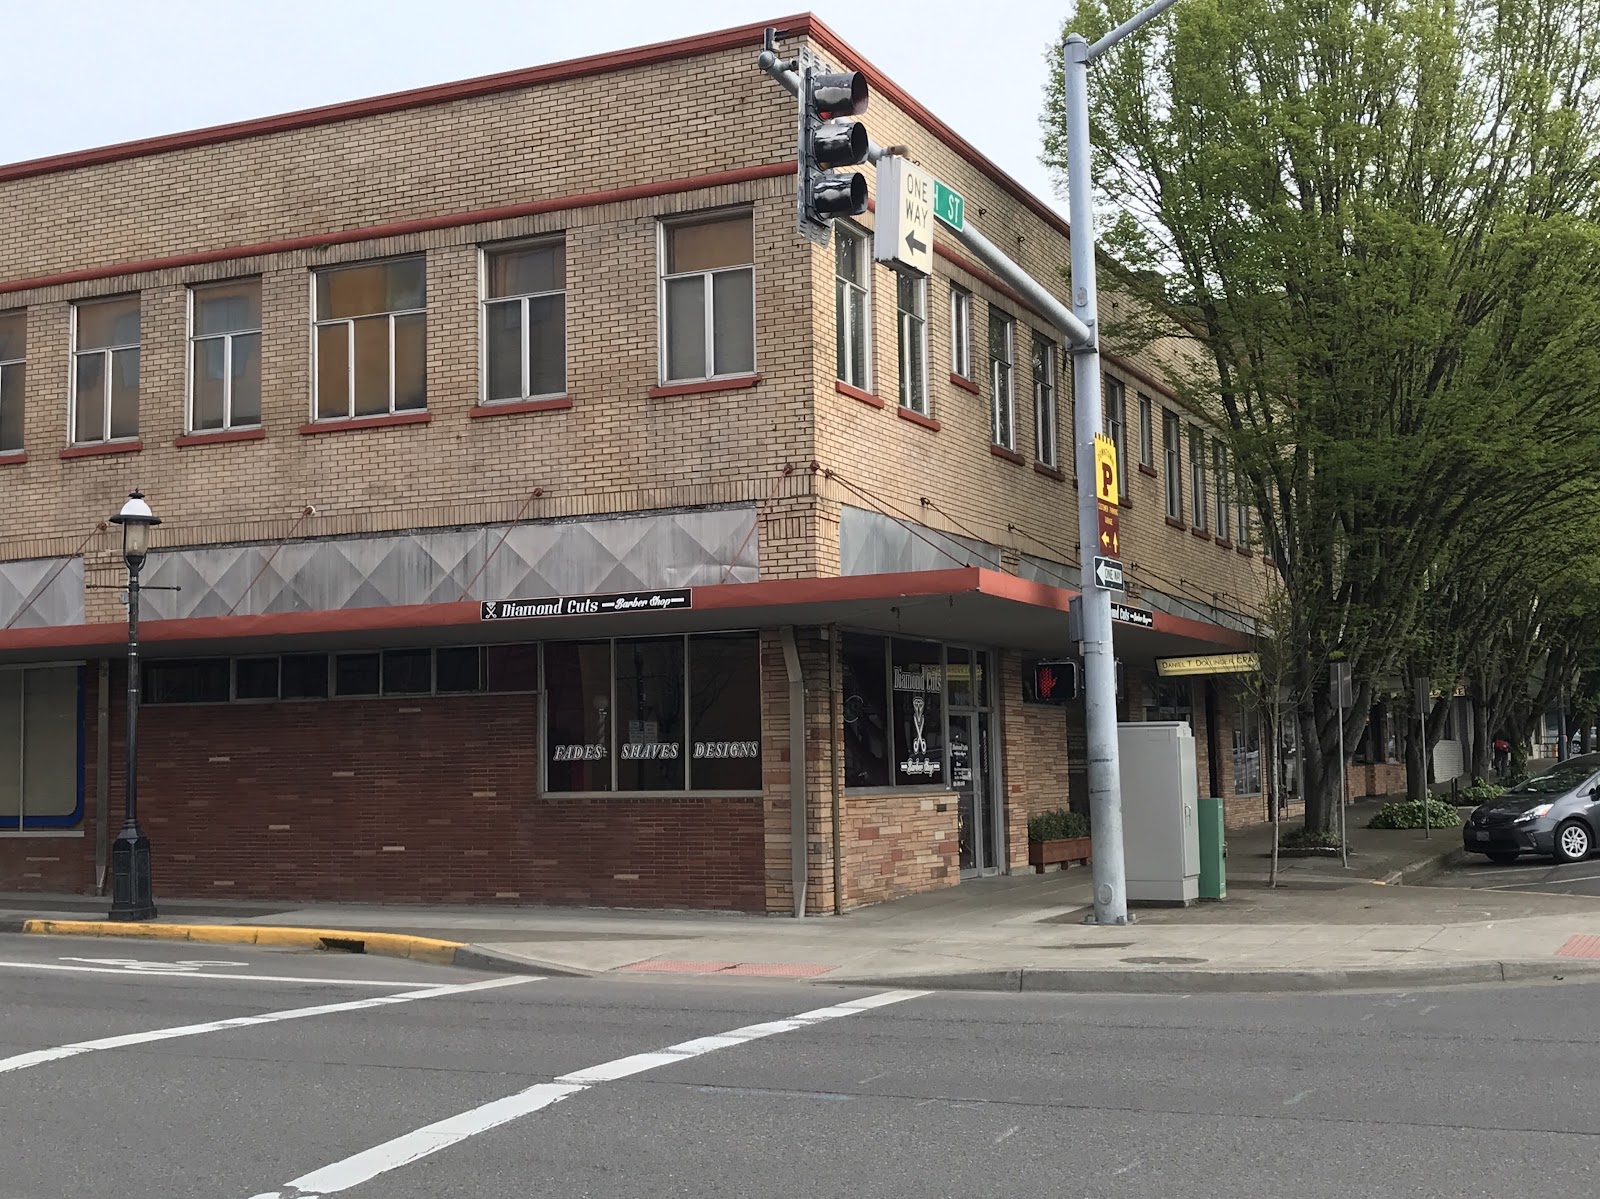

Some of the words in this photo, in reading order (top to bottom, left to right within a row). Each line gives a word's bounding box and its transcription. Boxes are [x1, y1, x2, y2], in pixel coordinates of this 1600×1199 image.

[907, 173, 928, 204] ONE
[906, 198, 929, 229] WAY
[947, 194, 961, 224] ST
[1101, 461, 1113, 497] P
[1104, 567, 1114, 581] ONE
[501, 598, 563, 618] Diamond
[567, 599, 599, 614] Cuts
[614, 598, 648, 610] Barber
[650, 595, 672, 608] Shop
[894, 664, 925, 693] Diamond
[553, 744, 603, 761] FADES
[621, 742, 680, 760] SHAVES
[693, 741, 760, 759] DESIGNS
